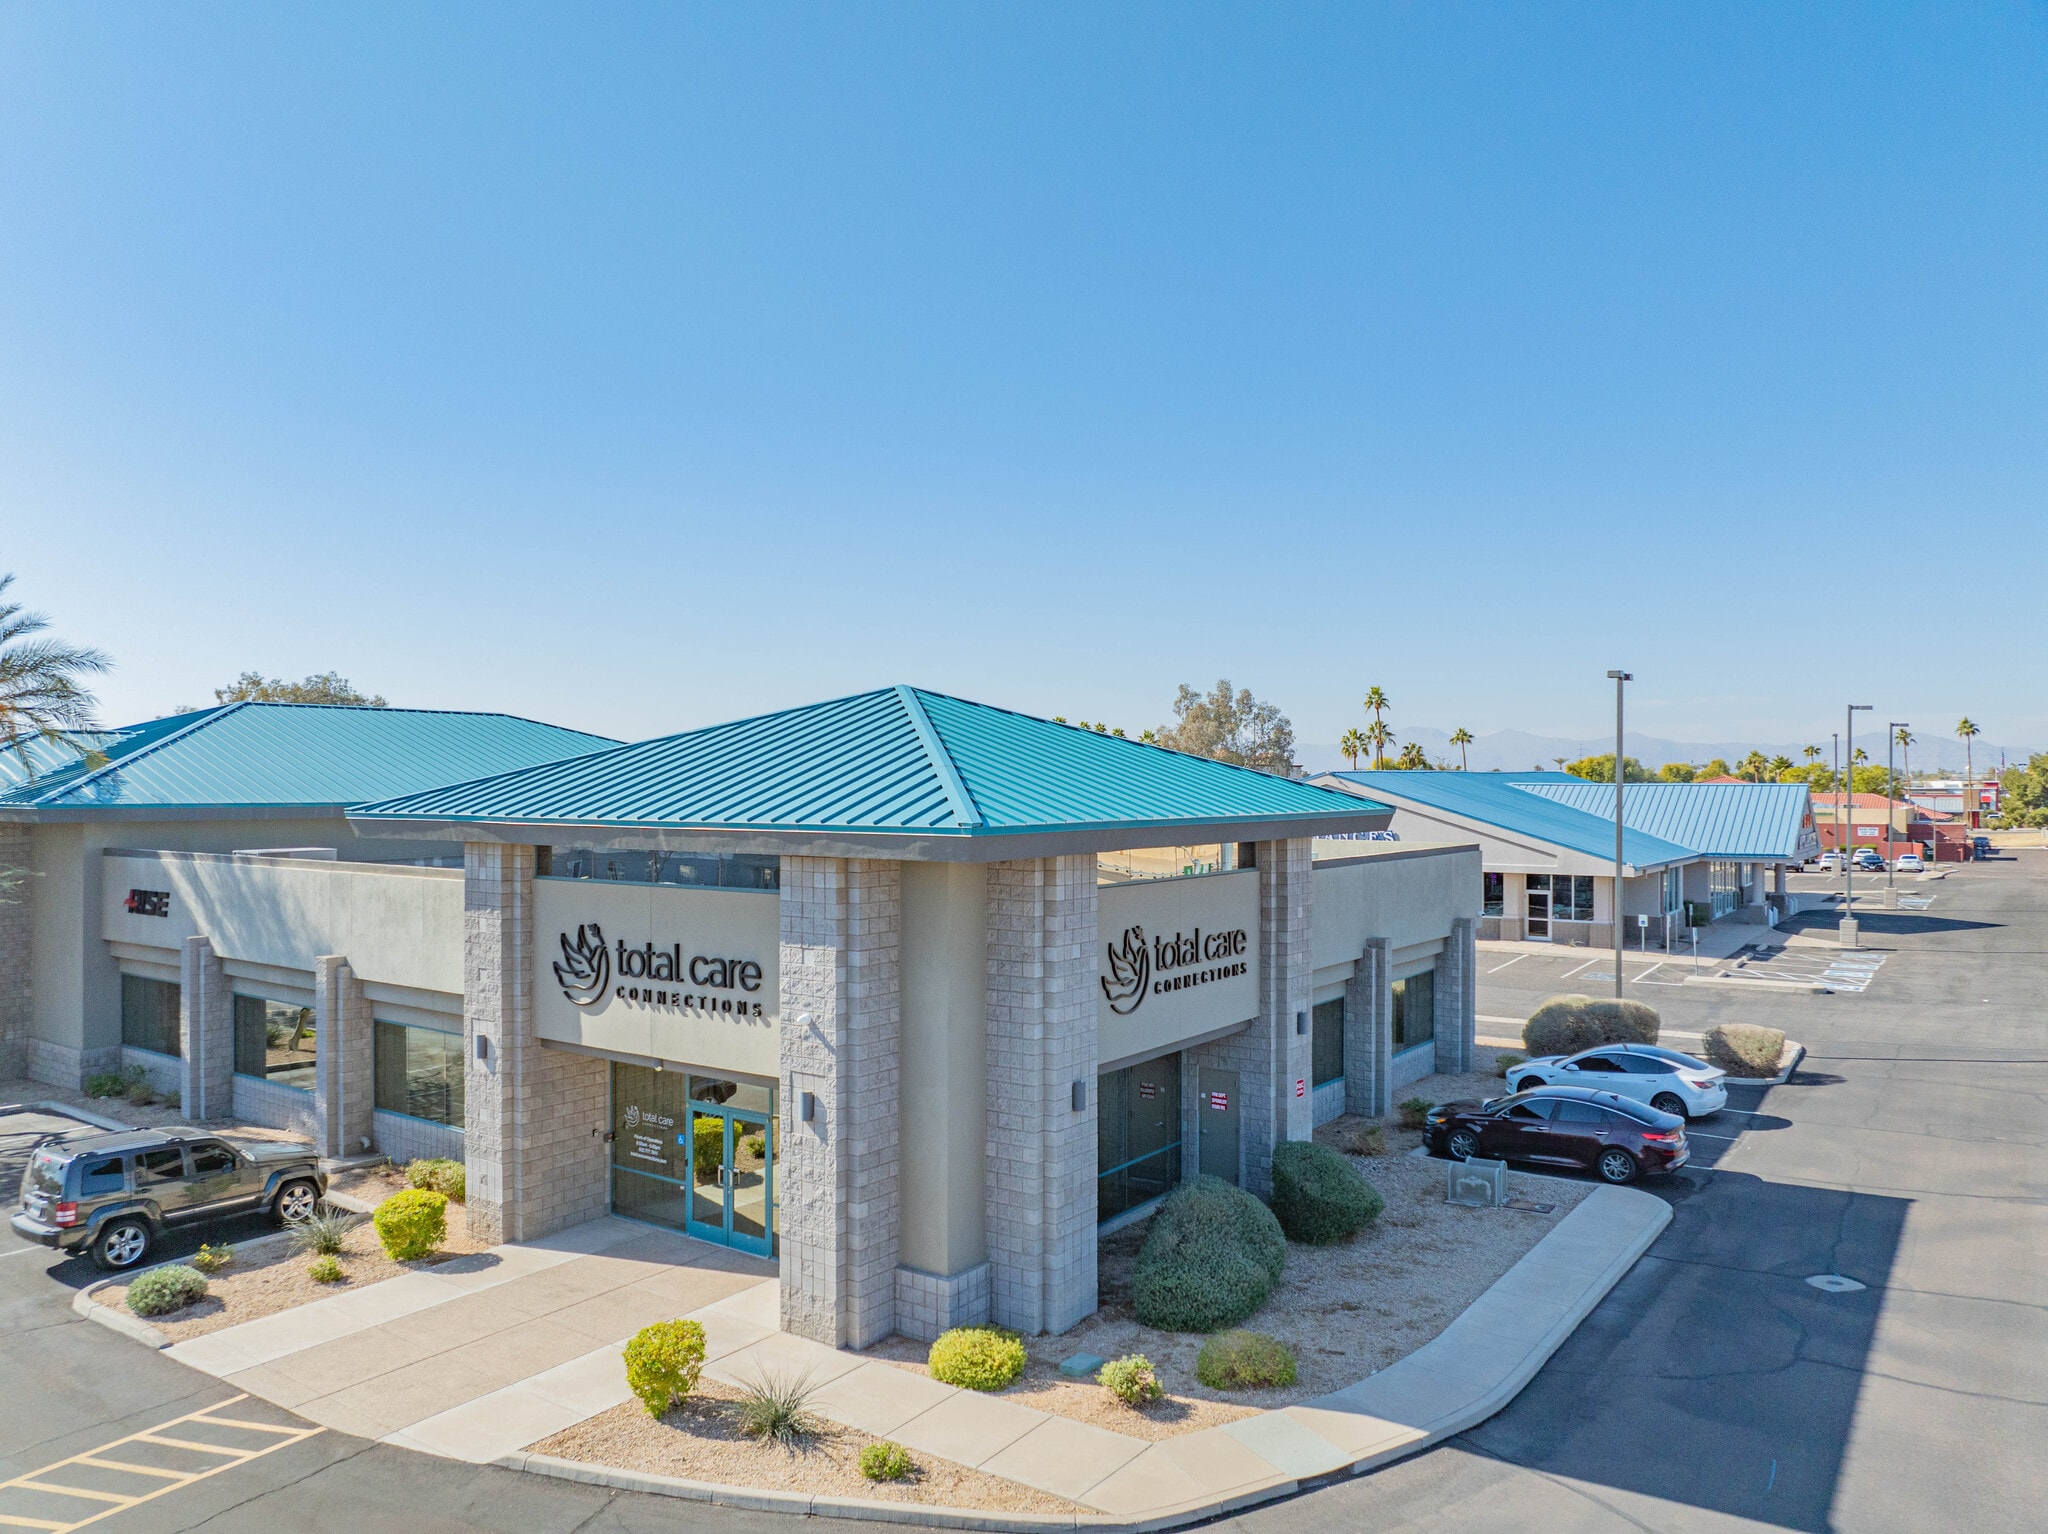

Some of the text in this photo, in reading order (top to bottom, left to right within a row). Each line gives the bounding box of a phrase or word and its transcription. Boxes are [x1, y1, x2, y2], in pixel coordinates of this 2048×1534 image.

[127, 889, 170, 917] RISE
[616, 939, 762, 992] total care
[1154, 928, 1247, 971] total care
[1154, 962, 1247, 994] CONNECTIONS
[616, 986, 762, 1018] CONNECTIONS
[642, 1112, 657, 1123] total
[658, 1116, 674, 1126] care
